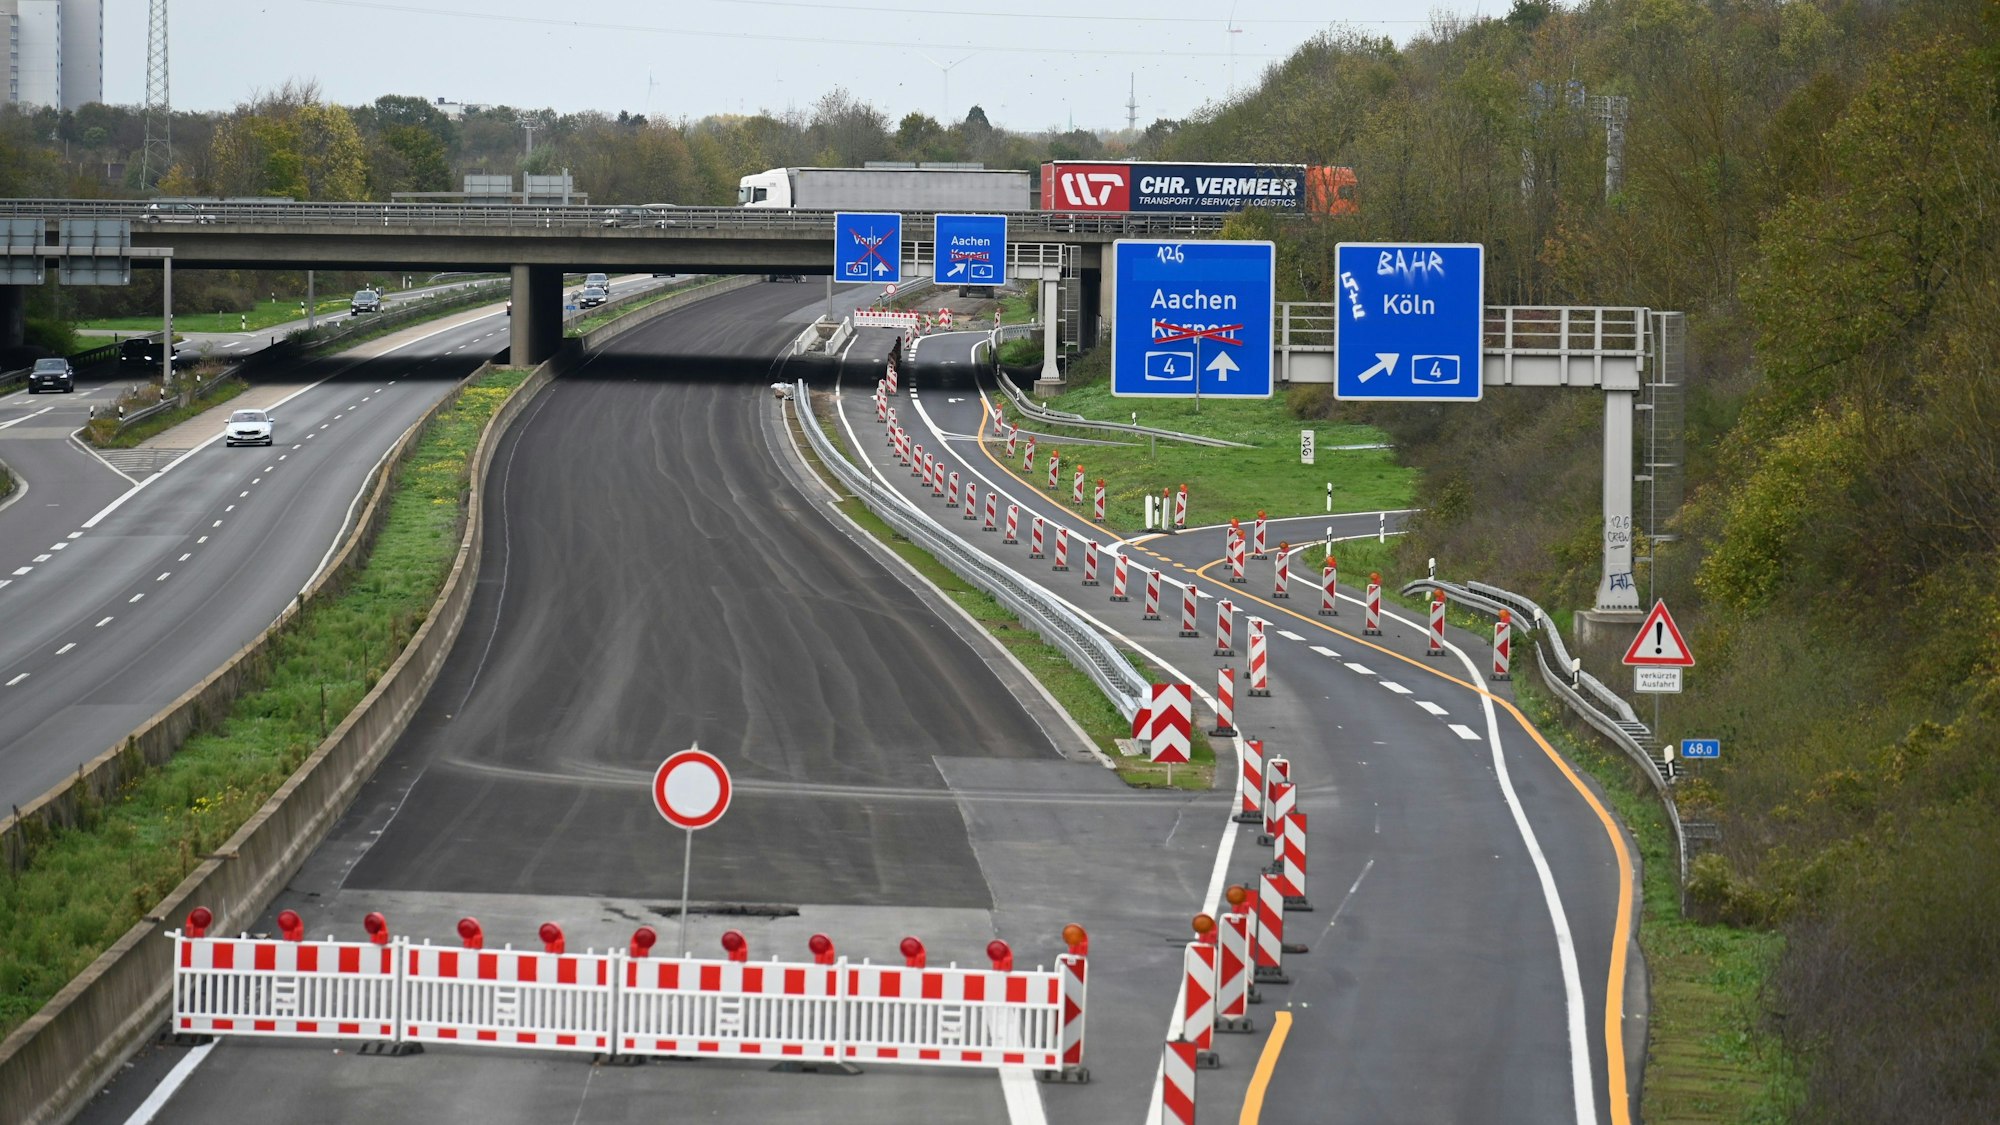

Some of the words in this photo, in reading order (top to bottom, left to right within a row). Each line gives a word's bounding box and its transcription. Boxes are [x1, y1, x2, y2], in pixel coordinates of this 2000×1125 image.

[1139, 176, 1190, 194] CHR.
[1195, 177, 1297, 196] VERMEER
[1139, 196, 1194, 205] TRANSPORT
[1200, 198, 1241, 206] SERVICE
[1248, 198, 1297, 207] LOGISTICS
[951, 235, 990, 246] Aachen
[1156, 245, 1185, 263] 126
[853, 265, 862, 273] 61
[1377, 249, 1444, 276] BAHR
[979, 267, 985, 275] 4
[1150, 288, 1237, 310] Aachen
[1383, 294, 1435, 315] Köln
[1163, 357, 1175, 375] 4
[1430, 361, 1441, 379] 4
[1610, 515, 1630, 529] 126
[1640, 671, 1677, 680] verkürzte
[1641, 680, 1675, 689] Ausfahrt
